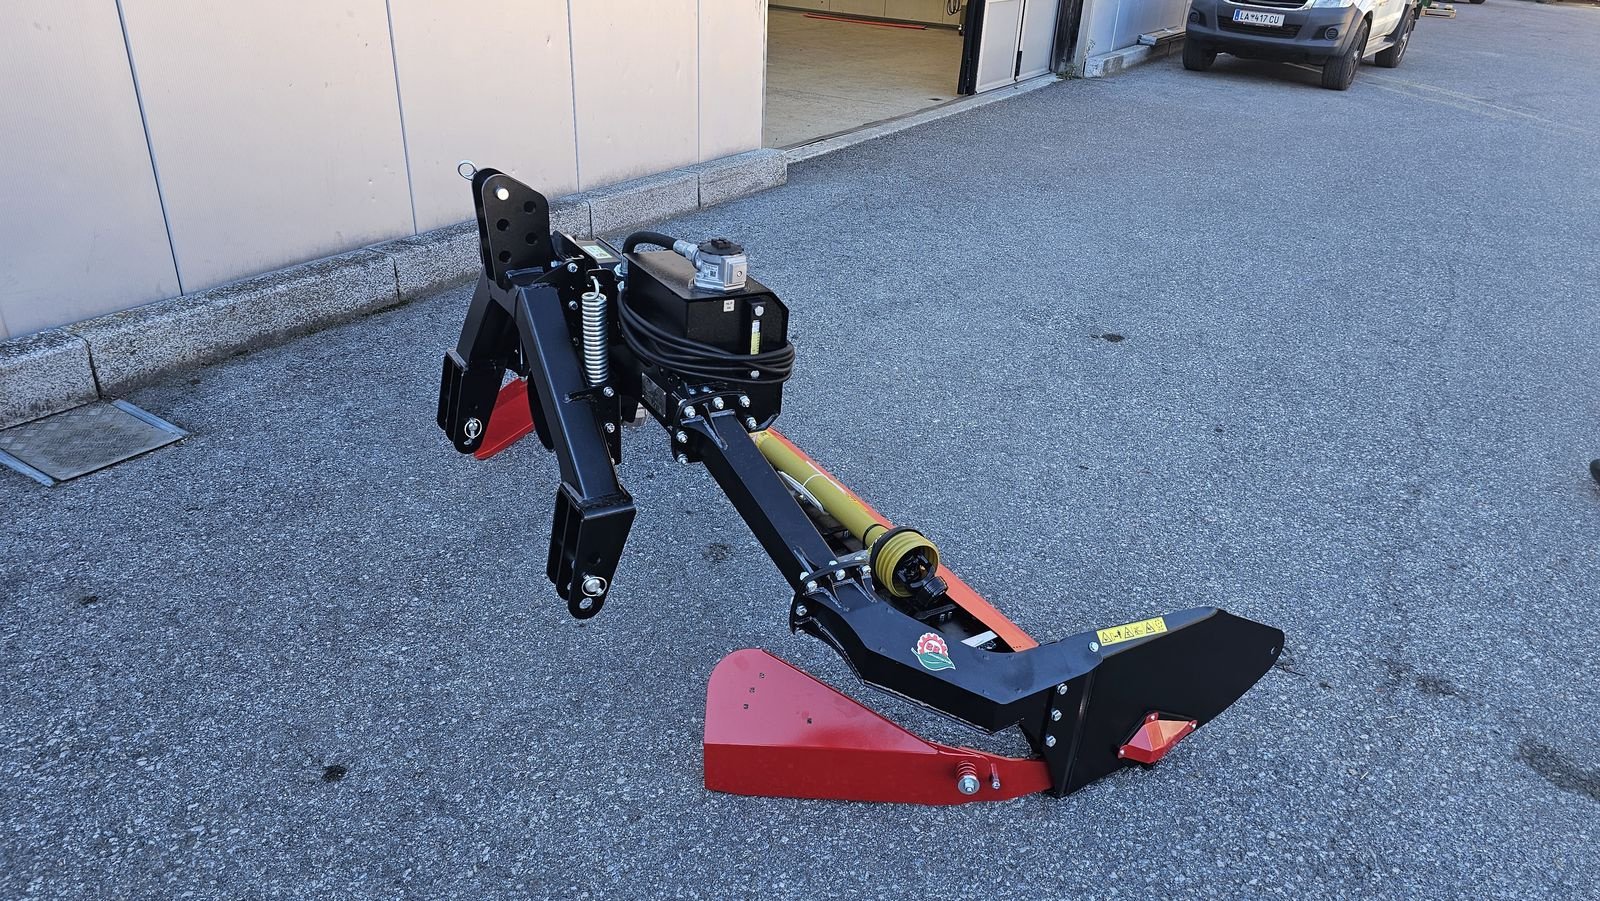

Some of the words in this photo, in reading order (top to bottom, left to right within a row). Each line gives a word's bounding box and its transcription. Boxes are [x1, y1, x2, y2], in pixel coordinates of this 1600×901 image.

[1240, 12, 1249, 20] LA
[1254, 14, 1268, 22] 417
[1269, 15, 1279, 24] CU
